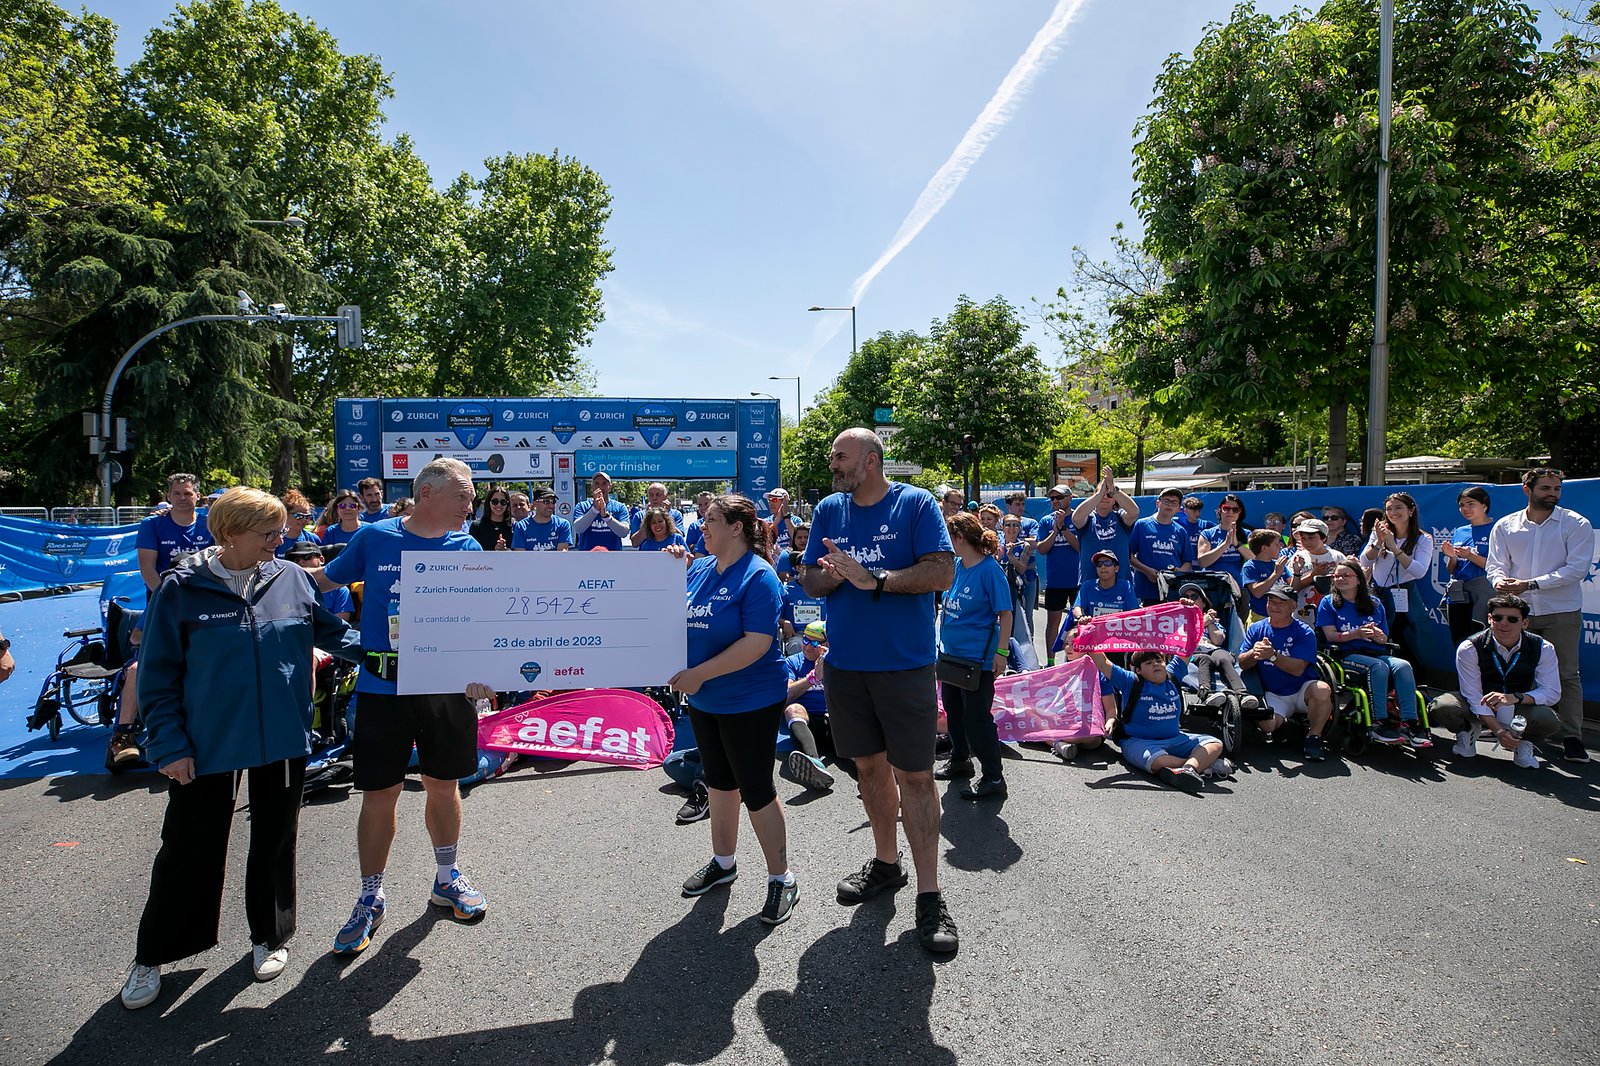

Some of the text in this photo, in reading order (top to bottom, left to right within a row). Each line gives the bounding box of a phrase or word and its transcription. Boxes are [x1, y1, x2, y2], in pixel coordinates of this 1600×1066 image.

[582, 462, 660, 472] 1€ por finisher
[578, 580, 615, 589] AEFAT
[1105, 611, 1187, 636] aefat
[493, 636, 602, 648] 23 de abril de 2023
[554, 666, 584, 676] aefat
[518, 716, 650, 756] aefat
